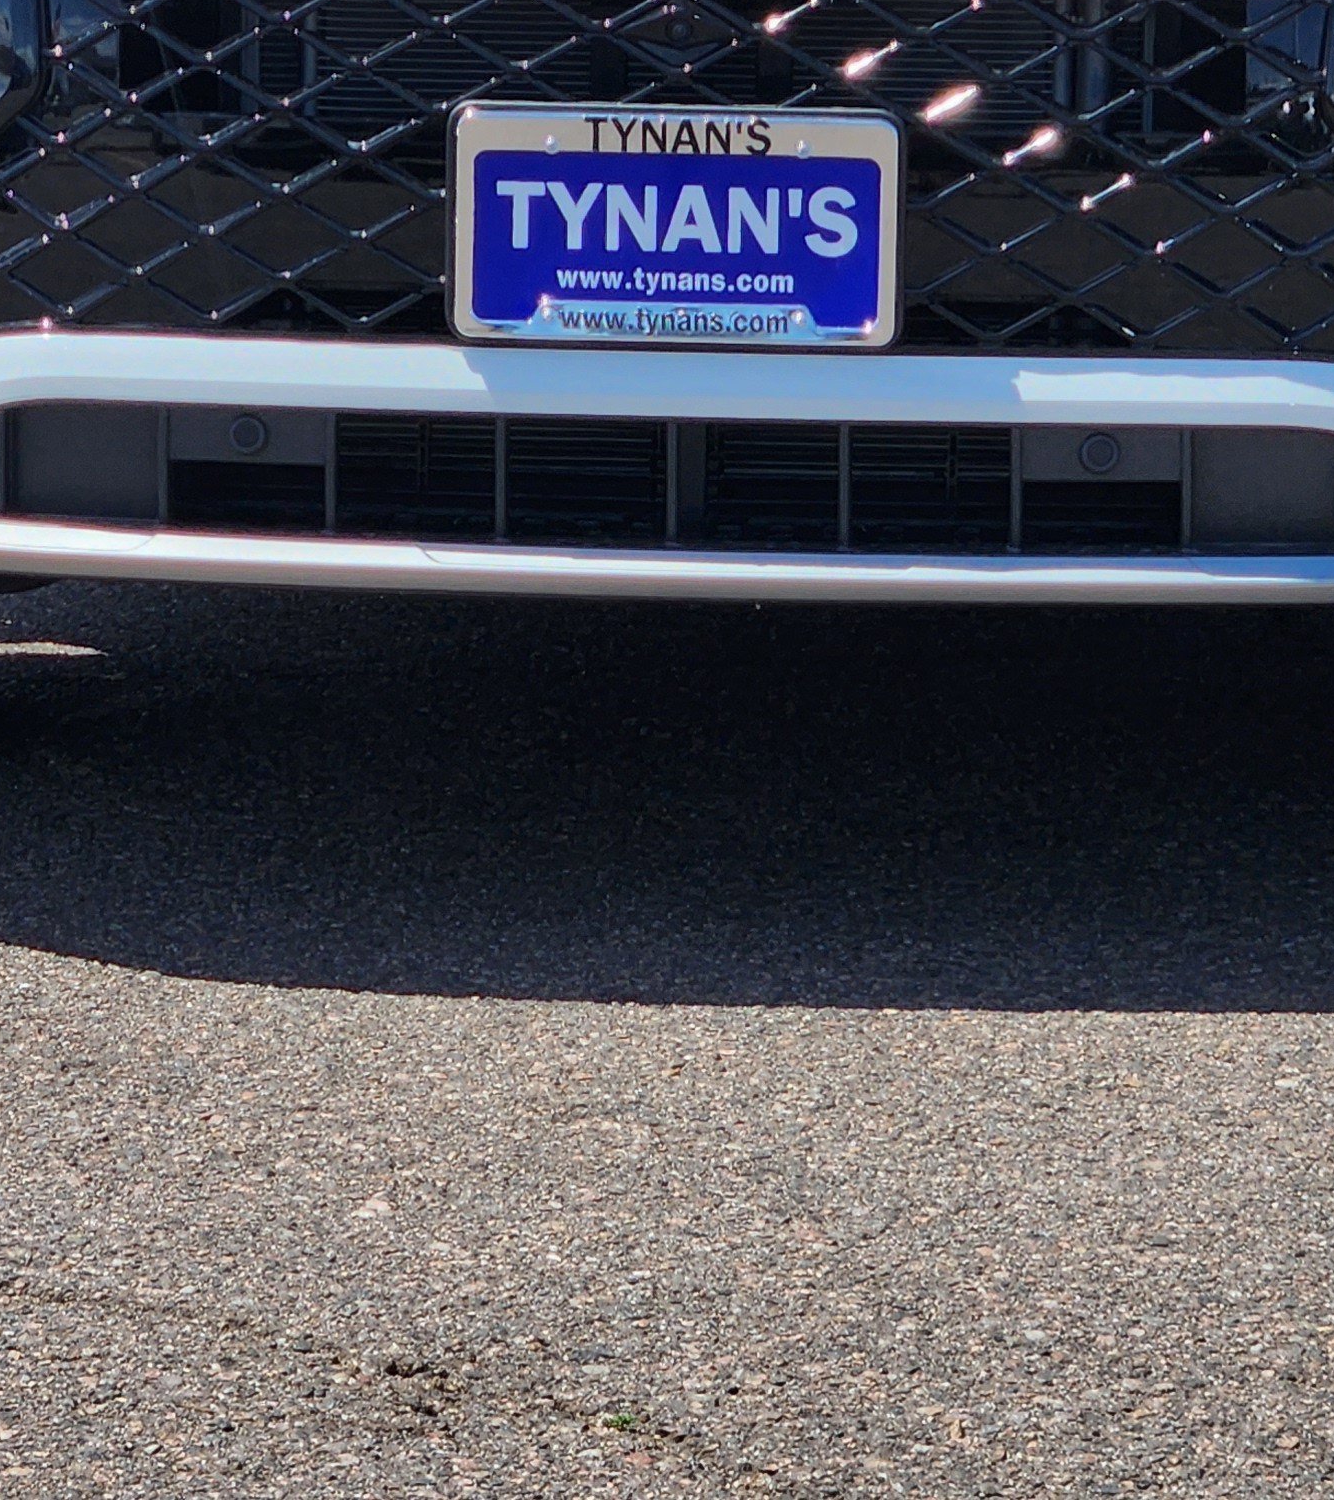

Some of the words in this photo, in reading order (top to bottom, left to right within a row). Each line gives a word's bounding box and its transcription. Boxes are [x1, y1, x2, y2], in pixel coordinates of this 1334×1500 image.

[583, 117, 773, 156] TYNAN'S
[496, 180, 859, 259] TYNAN'S
[556, 268, 795, 297] www.tynans.com
[559, 306, 790, 336] www.tynans.com
